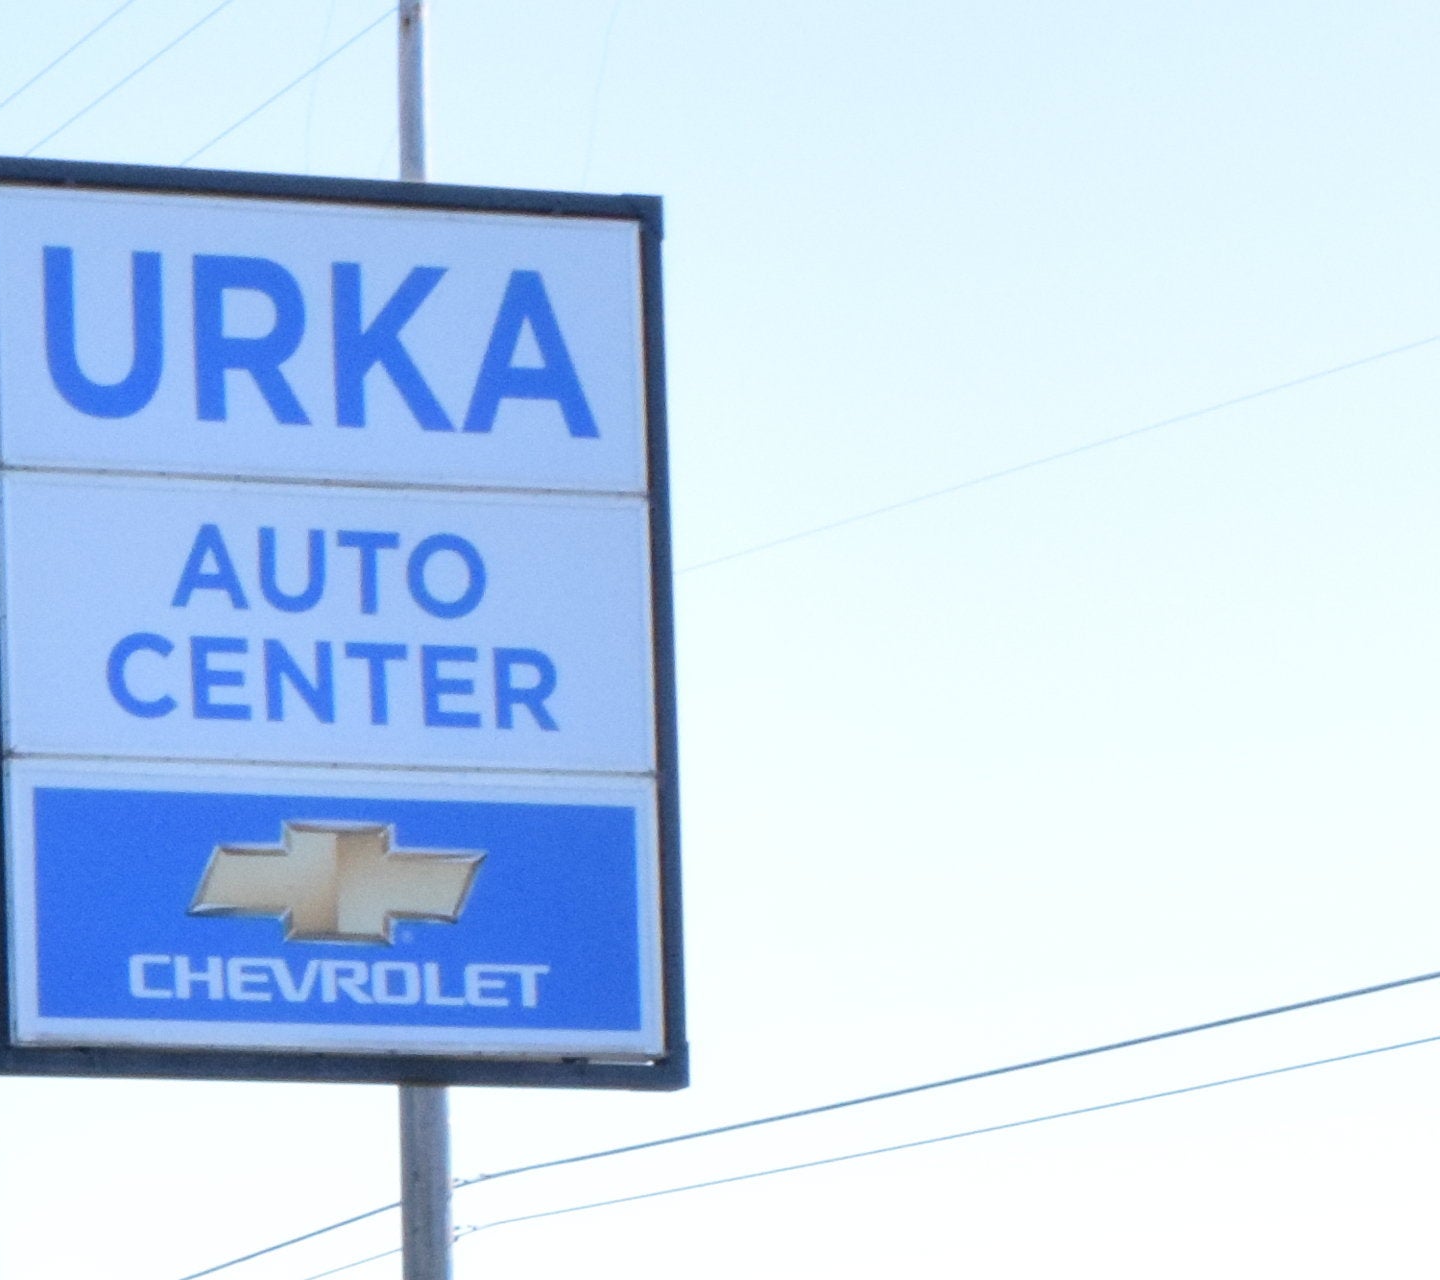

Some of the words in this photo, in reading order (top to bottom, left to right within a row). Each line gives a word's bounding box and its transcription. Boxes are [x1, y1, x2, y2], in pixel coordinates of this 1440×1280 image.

[41, 242, 601, 440] URKA
[170, 521, 489, 622] AUTO
[106, 629, 560, 733] CENTER
[127, 953, 551, 1008] CHEVROLET
